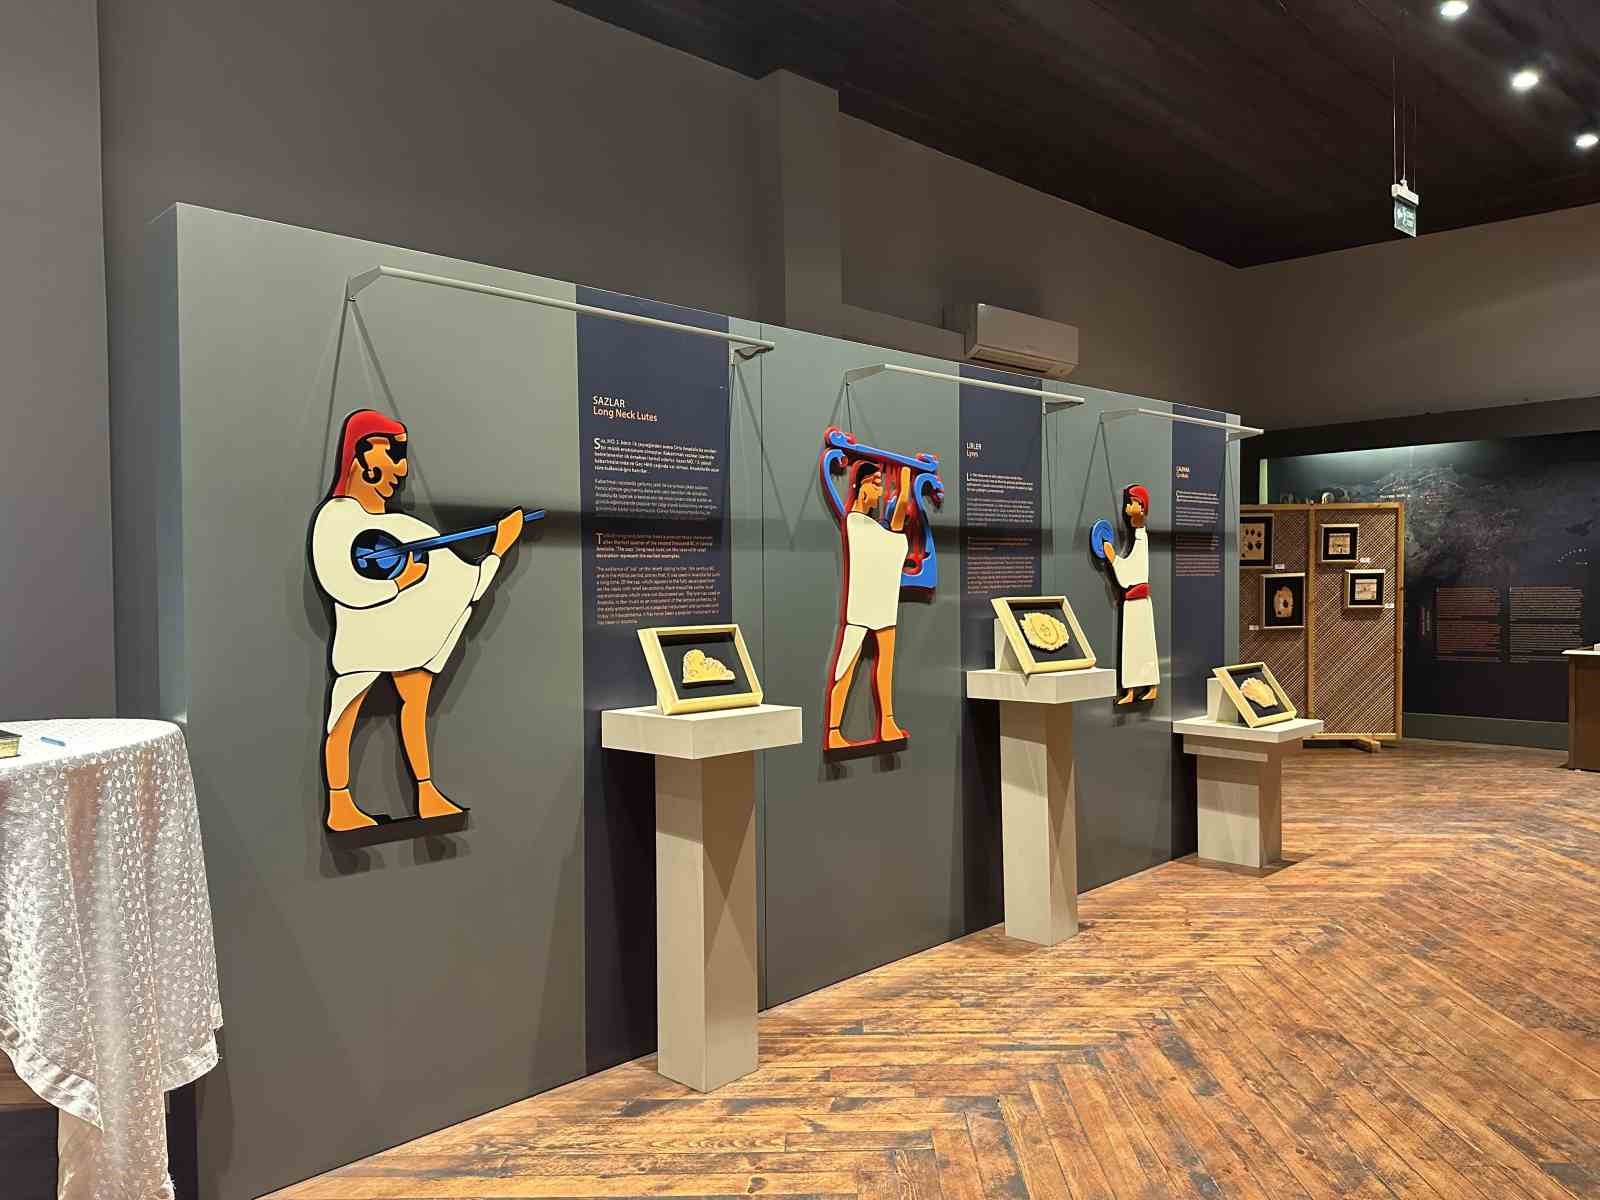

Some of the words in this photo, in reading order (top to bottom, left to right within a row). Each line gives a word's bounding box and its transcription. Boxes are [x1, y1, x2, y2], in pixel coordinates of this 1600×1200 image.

[593, 395, 625, 408] SAZLAR
[593, 406, 614, 419] Long
[615, 409, 636, 420] Neck
[636, 411, 658, 422] Lutes
